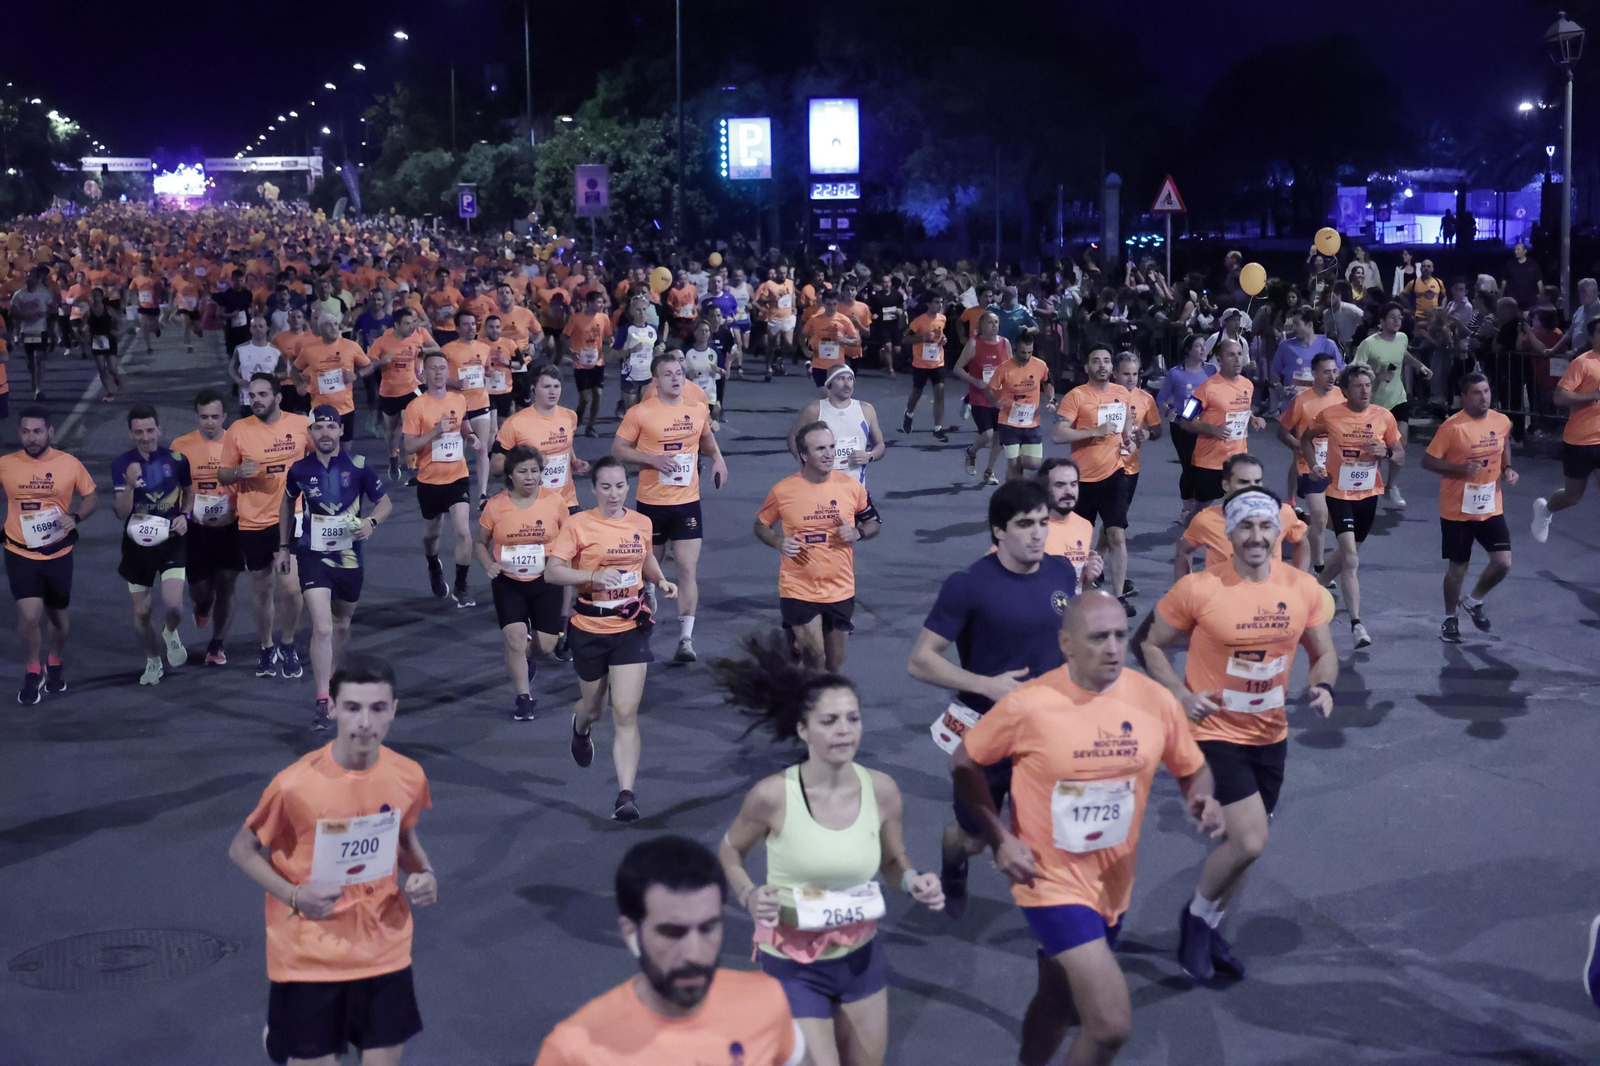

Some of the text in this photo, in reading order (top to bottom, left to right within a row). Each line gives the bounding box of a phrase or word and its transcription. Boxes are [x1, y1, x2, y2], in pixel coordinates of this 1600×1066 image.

[813, 184, 856, 198] 22:02
[1104, 412, 1123, 421] 18262
[440, 441, 459, 450] 14717
[544, 465, 566, 476] 20490
[1350, 471, 1369, 479] 6659
[204, 505, 224, 514] 6197
[32, 519, 58, 533] 16894
[138, 525, 159, 536] 2871
[321, 527, 343, 537] 2883
[511, 555, 537, 565] 11271
[606, 588, 630, 600] 1342
[1235, 622, 1270, 630] SEVILLA
[1093, 739, 1139, 748] NOCTURNA
[1072, 749, 1114, 759] SEVILLA
[1071, 803, 1121, 822] 17728
[341, 837, 380, 859] 7200
[822, 906, 865, 927] 2645
